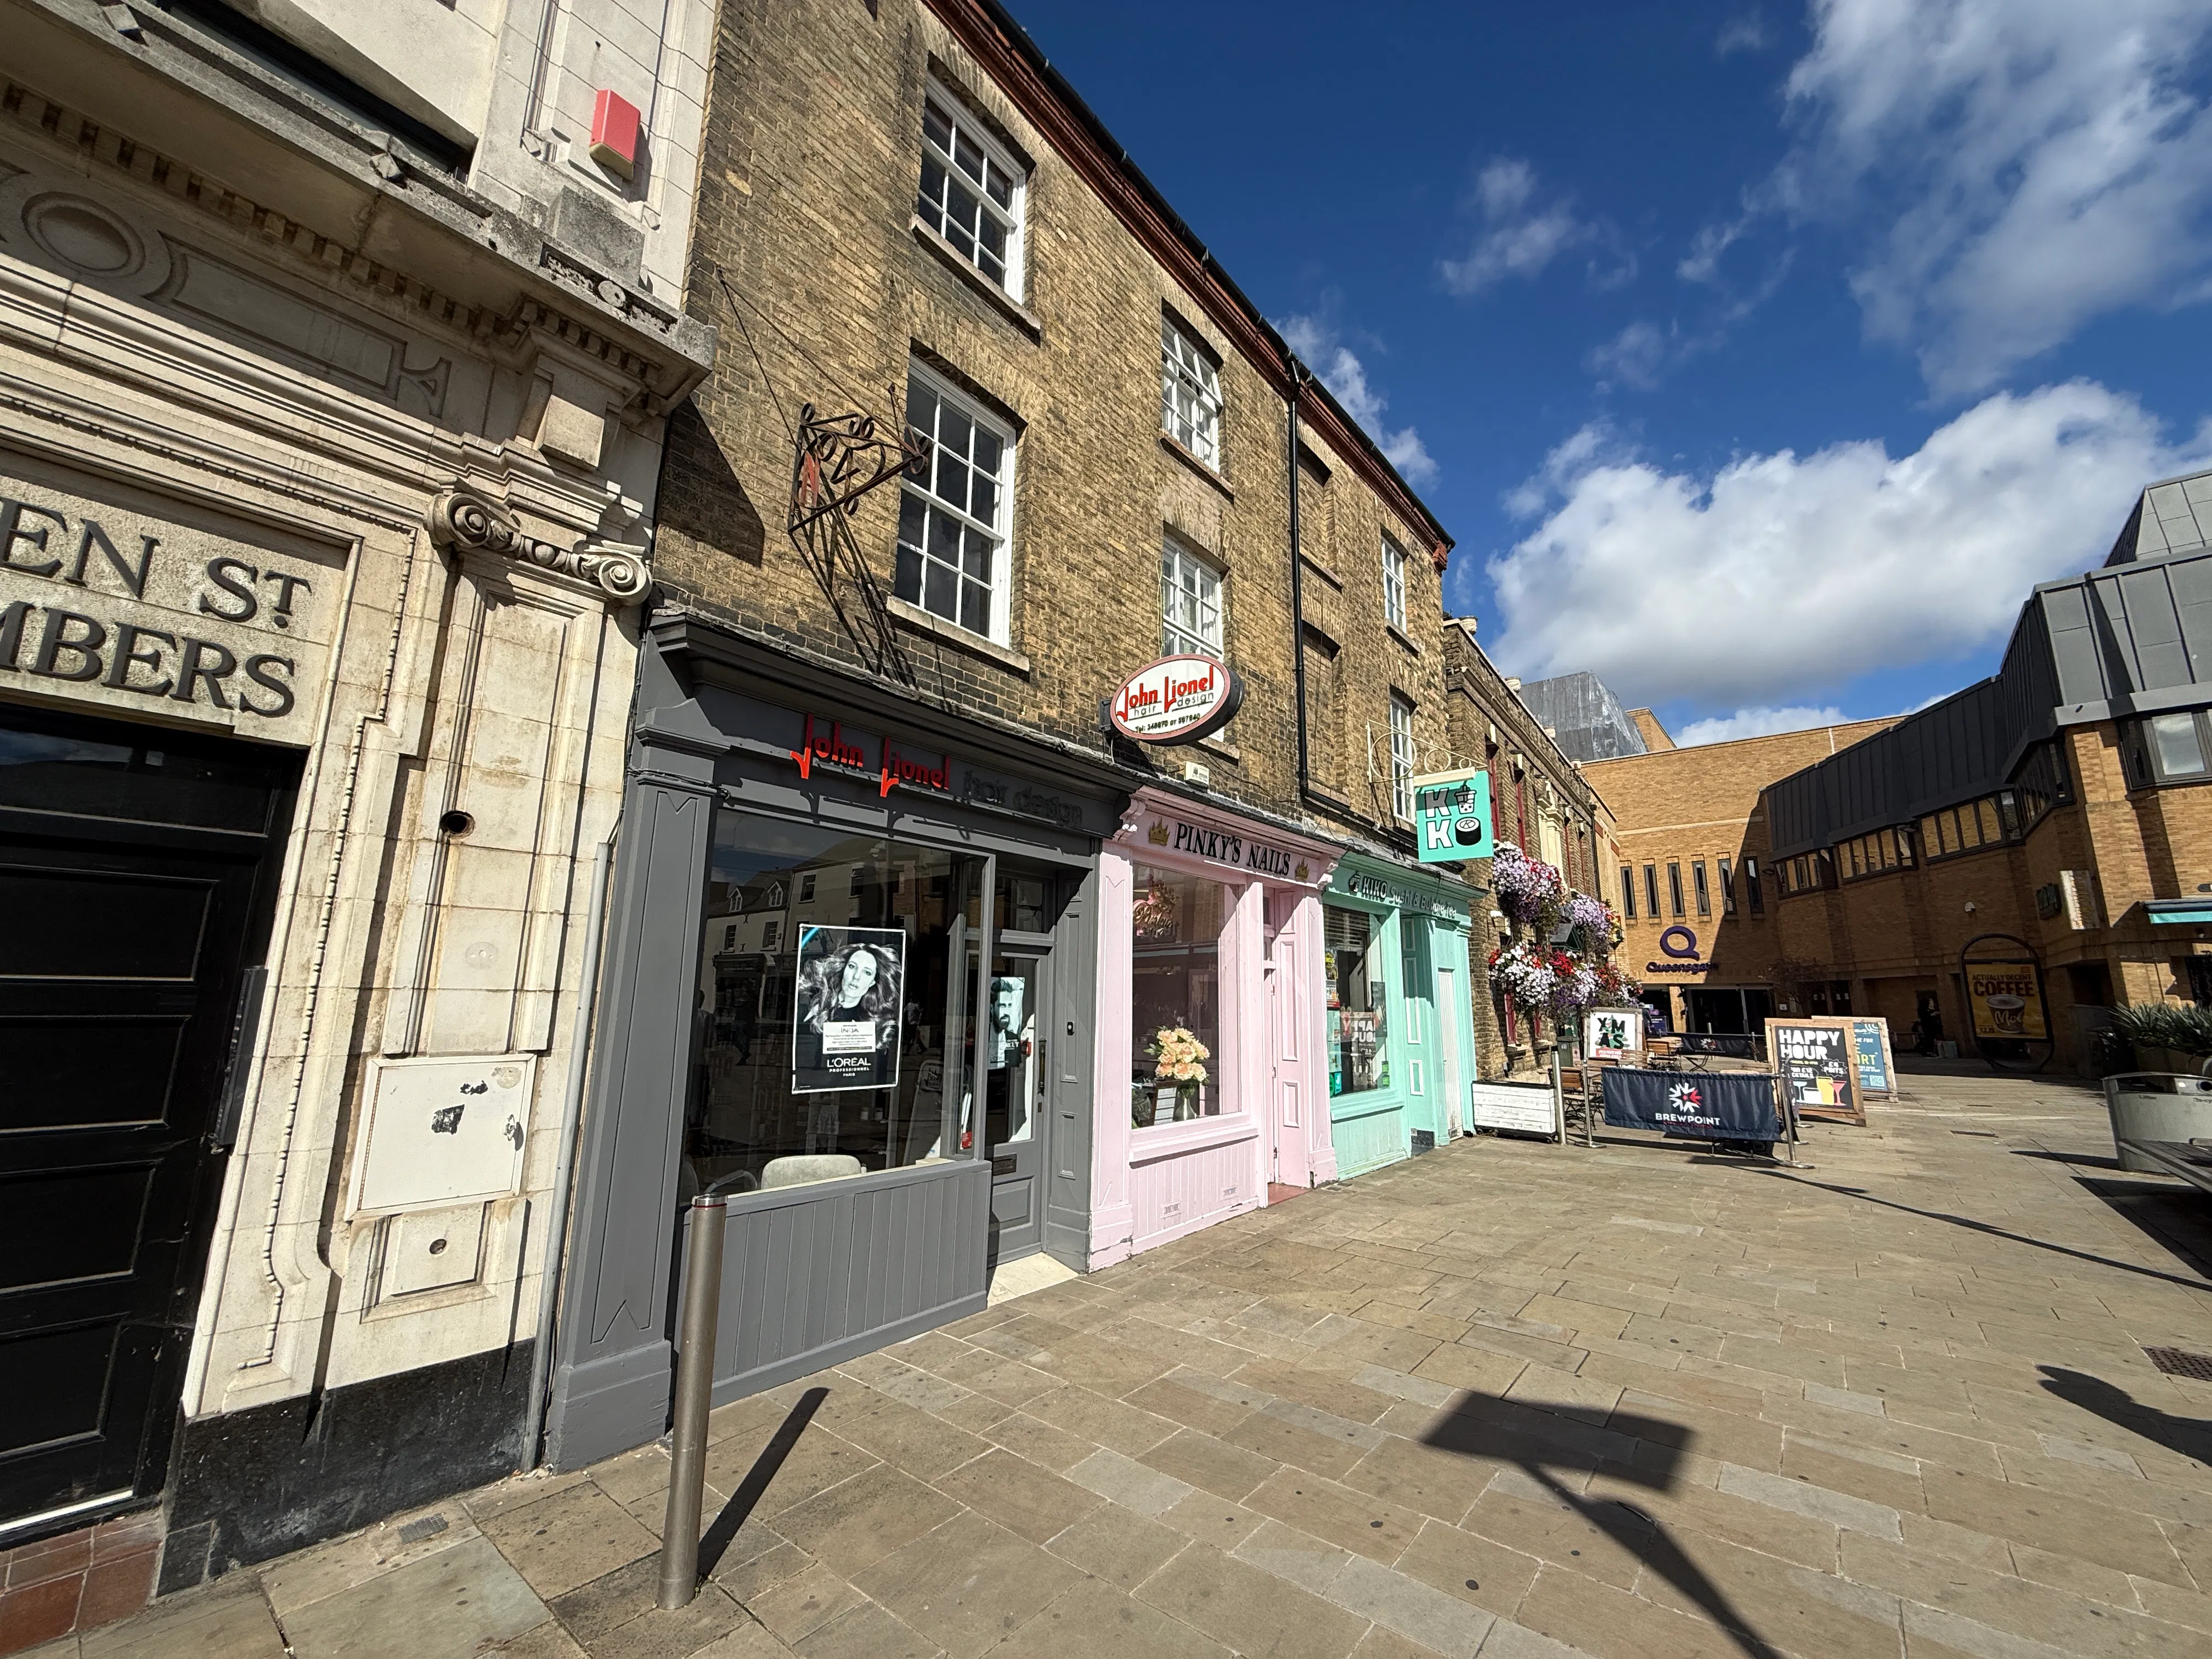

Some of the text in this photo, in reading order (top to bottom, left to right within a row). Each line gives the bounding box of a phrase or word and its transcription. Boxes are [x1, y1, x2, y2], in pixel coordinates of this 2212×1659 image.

[1116, 664, 1214, 722] John Lionel
[1134, 692, 1214, 717] hair design
[790, 712, 864, 780] John
[880, 736, 951, 798] Lionel
[1173, 822, 1291, 876] PINKY'S NAILS
[1362, 876, 1387, 899] KIKO
[1390, 887, 1412, 905] Sushi
[1413, 893, 1420, 906] &
[1974, 981, 2035, 997] COFFEE
[1779, 1029, 1840, 1046] HAPPY
[827, 1057, 871, 1068] L'ORÉAL
[1780, 1044, 1828, 1060] HOUR
[1655, 1113, 1720, 1126] BREWPOINT
